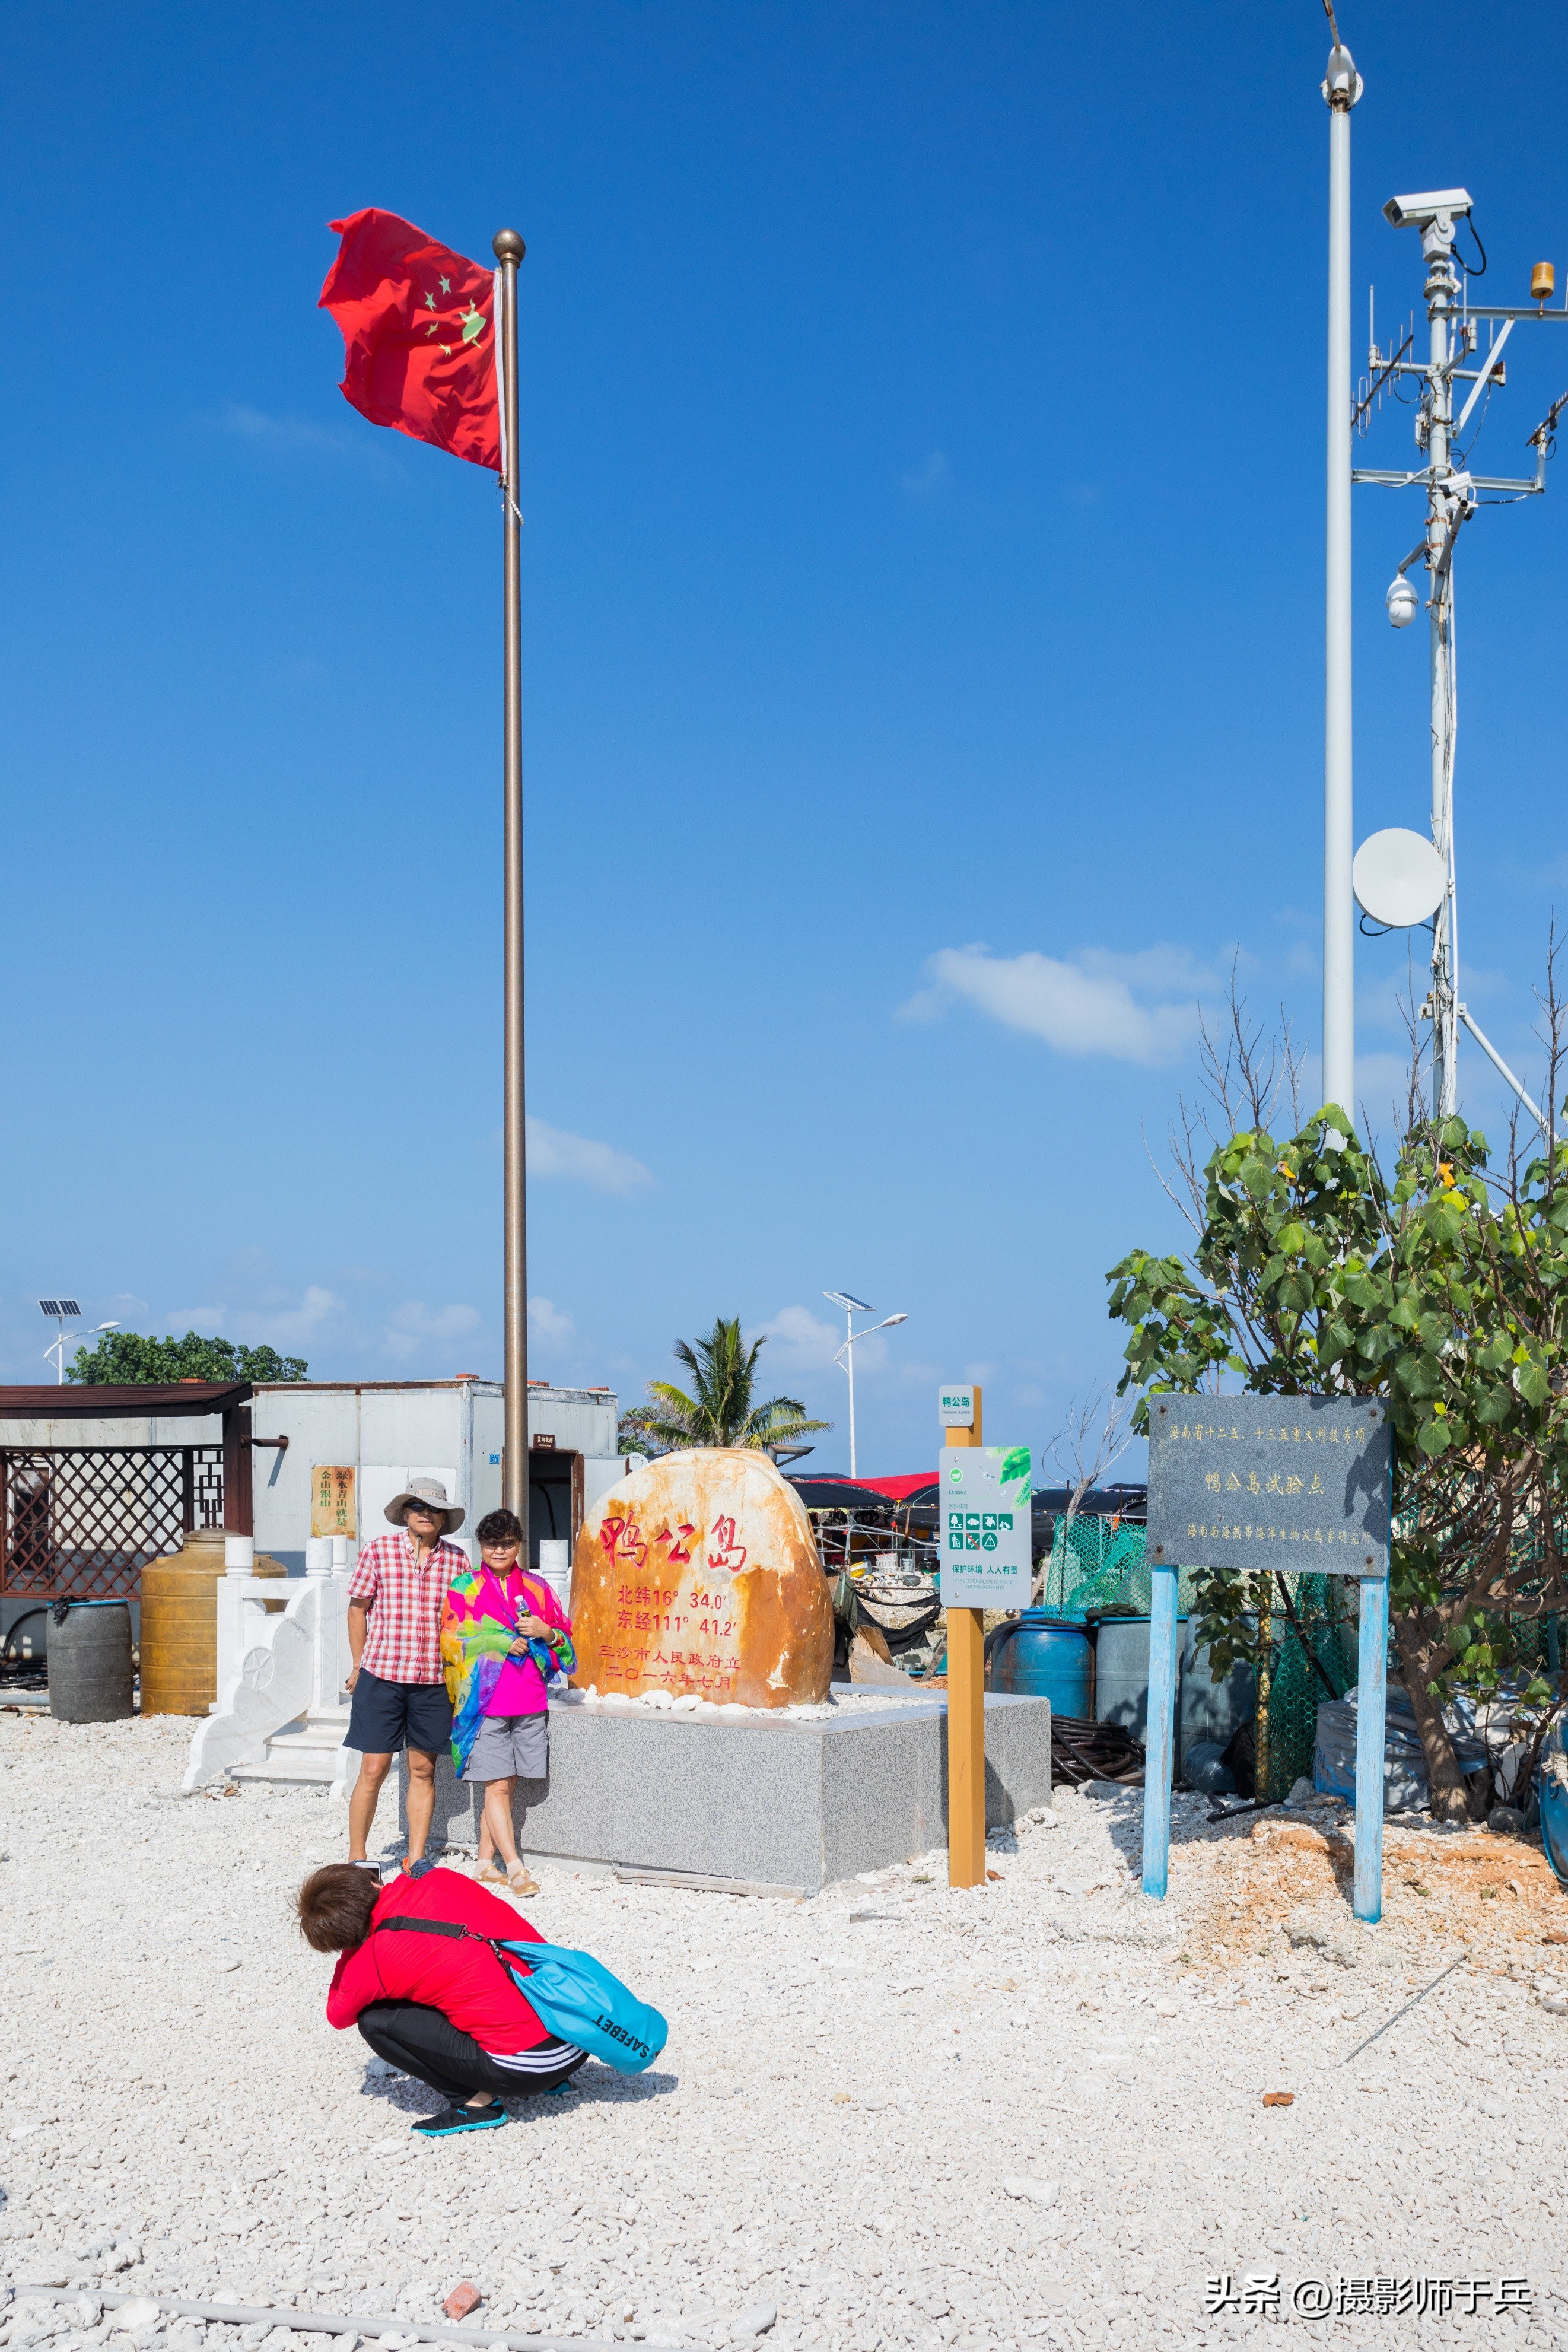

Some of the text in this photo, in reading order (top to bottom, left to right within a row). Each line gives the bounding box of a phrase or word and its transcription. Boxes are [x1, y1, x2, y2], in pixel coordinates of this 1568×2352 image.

[943, 1397, 969, 1407] 鸭公岛
[1206, 1471, 1324, 1495] 鸭公岛试验点
[599, 1510, 748, 1572] 鸭公岛
[952, 1565, 1018, 1575] 保护环境 人人有责
[598, 1645, 742, 1670] 三沙市人民政府立
[592, 2014, 650, 2058] SAFEBET
